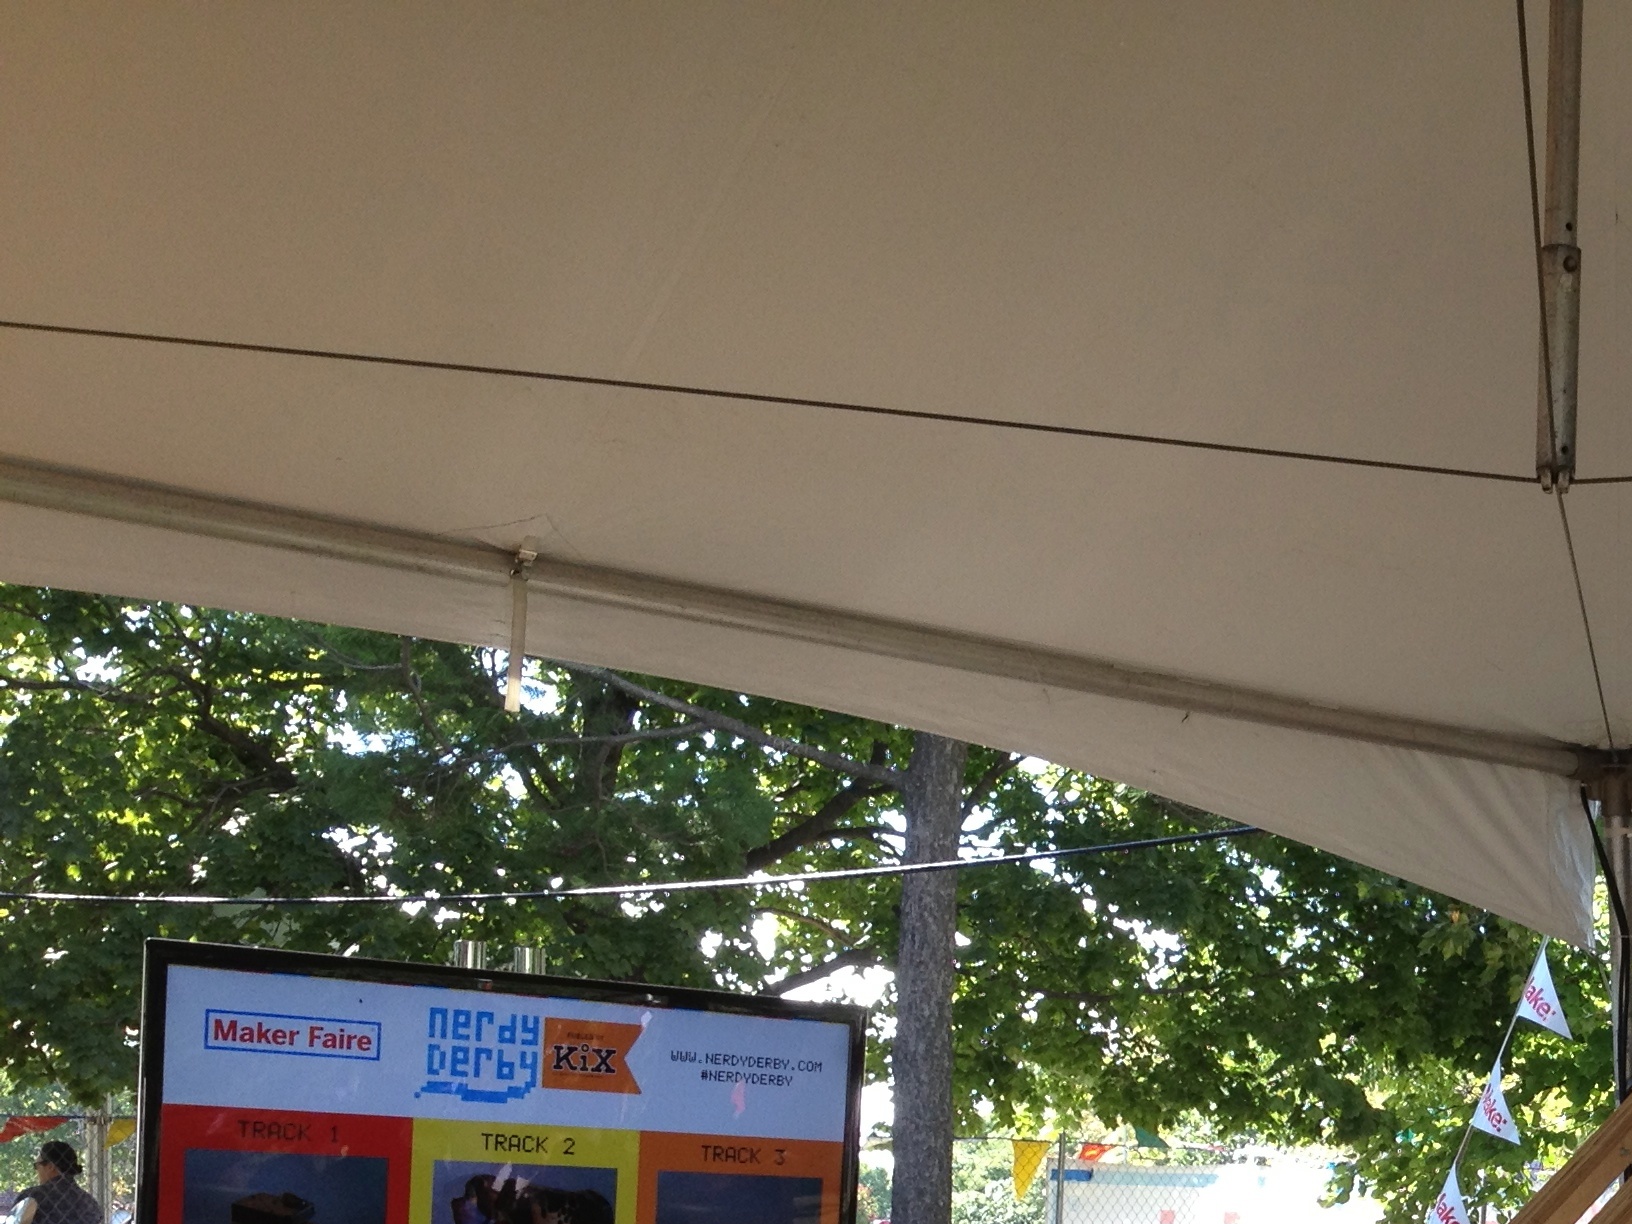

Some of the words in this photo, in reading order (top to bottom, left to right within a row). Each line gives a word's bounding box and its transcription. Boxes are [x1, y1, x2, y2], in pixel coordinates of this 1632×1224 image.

[1524, 976, 1557, 1022] ake:
[213, 1018, 300, 1046] Maker
[308, 1025, 372, 1052] Faire
[428, 1006, 540, 1046] nerdy
[670, 1050, 823, 1073] WWW.NERDYDERBY.COM
[700, 1069, 794, 1087] #NERDYDERBY
[236, 1119, 312, 1142] TRACK
[330, 1125, 340, 1144] 1
[481, 1132, 549, 1154] TRACK
[562, 1138, 577, 1156] 2
[701, 1145, 762, 1165] TRACK
[774, 1149, 787, 1166] 3
